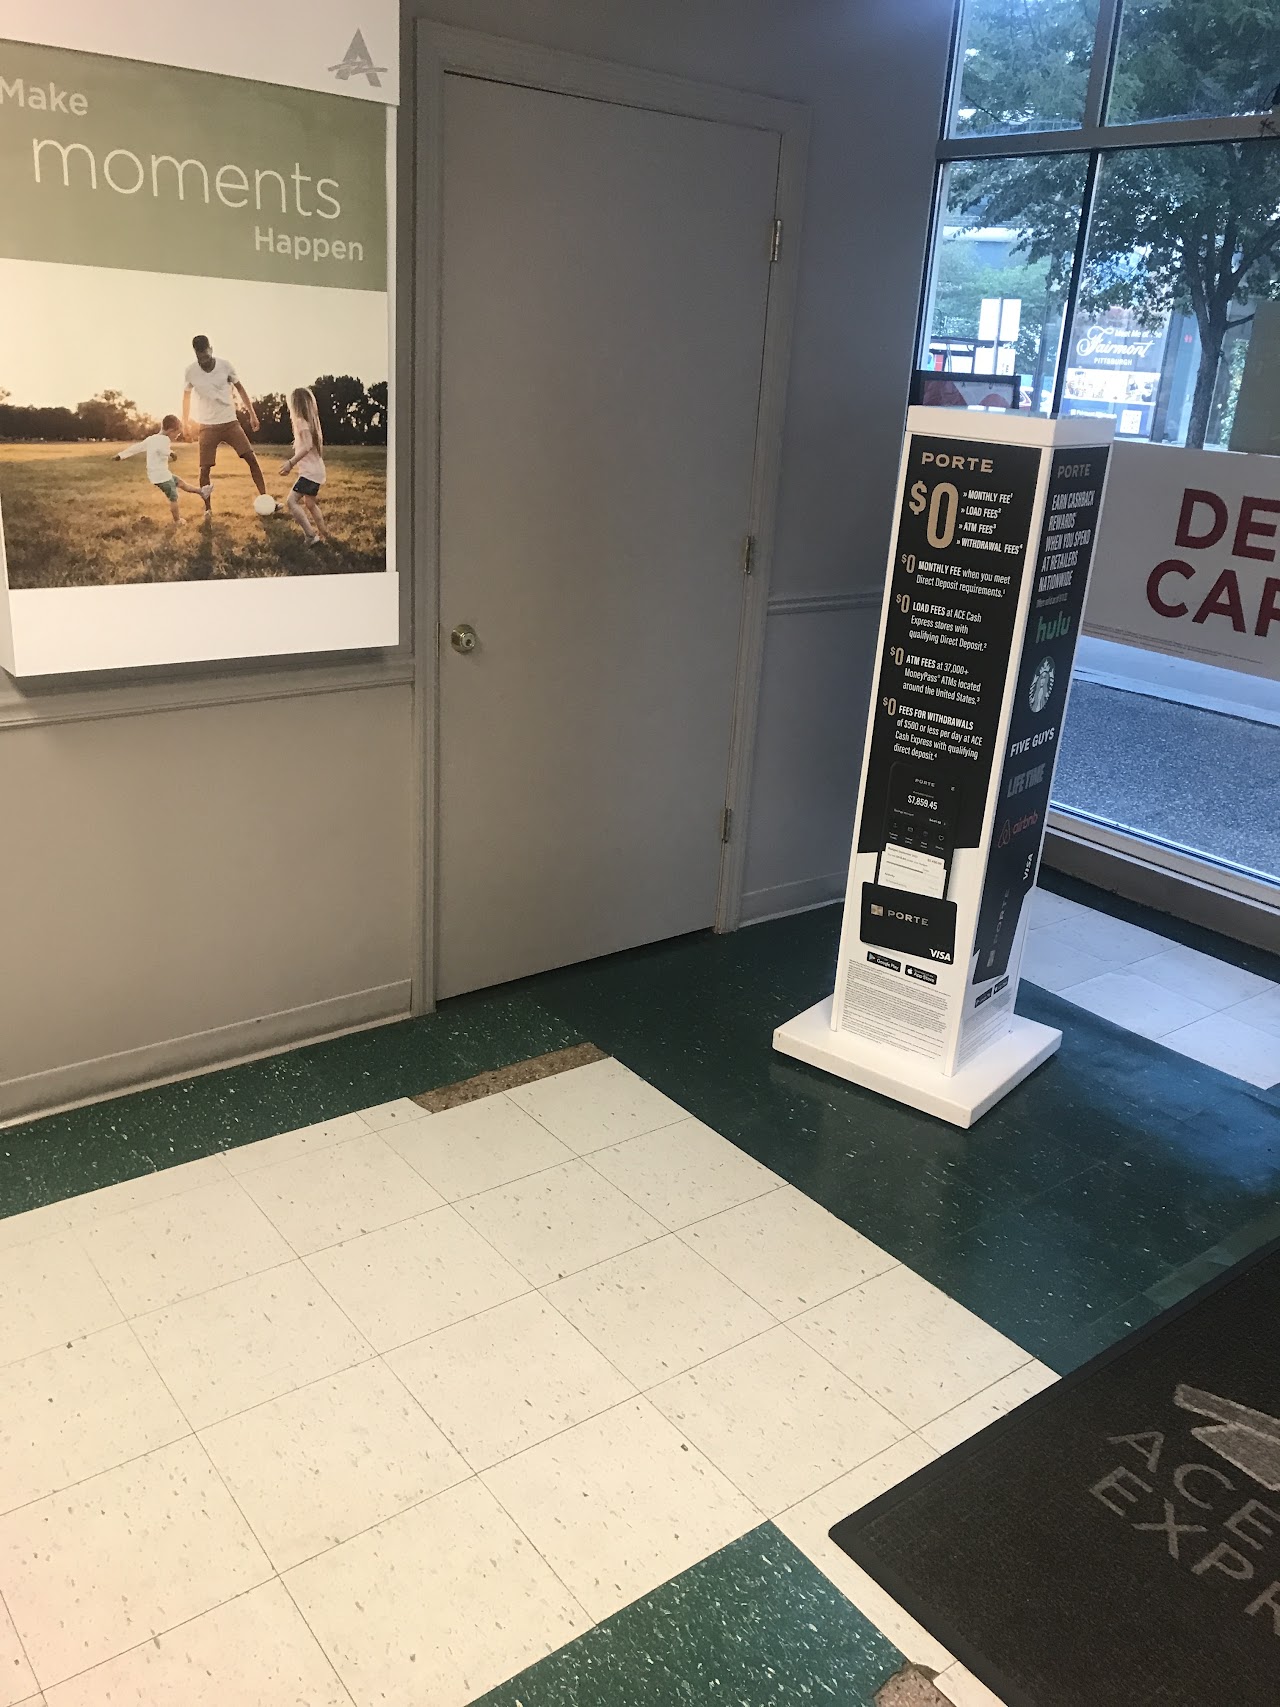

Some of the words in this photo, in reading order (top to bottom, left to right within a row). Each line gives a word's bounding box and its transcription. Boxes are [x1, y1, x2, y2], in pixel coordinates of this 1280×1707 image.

[0, 76, 89, 116] Make
[33, 138, 341, 219] moments
[255, 226, 364, 262] Happen
[1076, 325, 1155, 358] Fairmont
[1094, 357, 1132, 366] PITTSBURGH
[922, 452, 994, 473] PORTE
[1057, 464, 1091, 479] PORTE
[968, 490, 998, 502] MONTHLY
[1052, 494, 1068, 510] EARN
[1068, 490, 1095, 508] CASHBACK
[909, 480, 958, 549] $0
[966, 506, 982, 516] LOAD
[964, 522, 977, 532] ATM
[962, 538, 1002, 552] WITHDRAWAL
[1045, 534, 1064, 552] WHEN
[1062, 531, 1074, 549] YOU
[1074, 529, 1091, 546] SPEND
[902, 554, 916, 574] $0
[918, 561, 949, 574] MONTHLY
[950, 566, 962, 576] FEE
[962, 568, 980, 579] when
[980, 572, 993, 582] you
[994, 575, 1010, 585] meet
[1041, 556, 1050, 572] AT
[1050, 550, 1078, 570] RETAILERS
[916, 574, 934, 586] Direct
[935, 578, 958, 590] Deposit
[1038, 570, 1074, 592] NATIONWIDE
[896, 594, 910, 613] $0
[912, 602, 929, 612] LOAD
[930, 606, 945, 616] FEES
[946, 609, 954, 618] at
[954, 609, 966, 620] ACE
[966, 612, 982, 622] Cash
[911, 615, 934, 628] Express
[934, 620, 954, 632] stores
[954, 624, 968, 634] with
[1036, 610, 1071, 644] hulu
[909, 630, 939, 644] qualifying
[940, 634, 958, 647] Direct
[890, 646, 904, 666] $0
[906, 655, 920, 666] ATM
[920, 658, 936, 668] FEES
[936, 662, 942, 670] at
[944, 662, 969, 675] 37,000+
[903, 682, 923, 693] around
[925, 685, 934, 696] the
[936, 688, 956, 700] United
[940, 676, 956, 687] ATMs
[958, 679, 981, 692] located
[883, 697, 896, 716] $0
[899, 705, 913, 716] FEES
[914, 708, 926, 720] FOR
[927, 712, 974, 730] WITHDRAWALS
[897, 719, 903, 727] of
[904, 720, 919, 731] $500
[927, 725, 939, 736] less
[940, 730, 950, 738] per
[951, 732, 962, 744] day
[963, 734, 970, 744] at
[971, 736, 983, 746] ACE
[1010, 738, 1030, 758] FIVE
[1032, 727, 1055, 748] GUYS
[894, 743, 910, 755] direct
[896, 730, 909, 741] Cash
[910, 734, 932, 748] Express
[934, 740, 947, 750] with
[948, 744, 978, 760] qualifying
[914, 778, 936, 788] PORTE
[1007, 772, 1026, 798] LIFE
[908, 794, 938, 810] $7,859.45
[1012, 809, 1038, 834] airbnb
[1022, 853, 1034, 880] VISA
[888, 909, 929, 926] PORTE
[876, 959, 890, 967] Google
[929, 948, 952, 962] VISA
[1107, 1431, 1280, 1550] ACE
